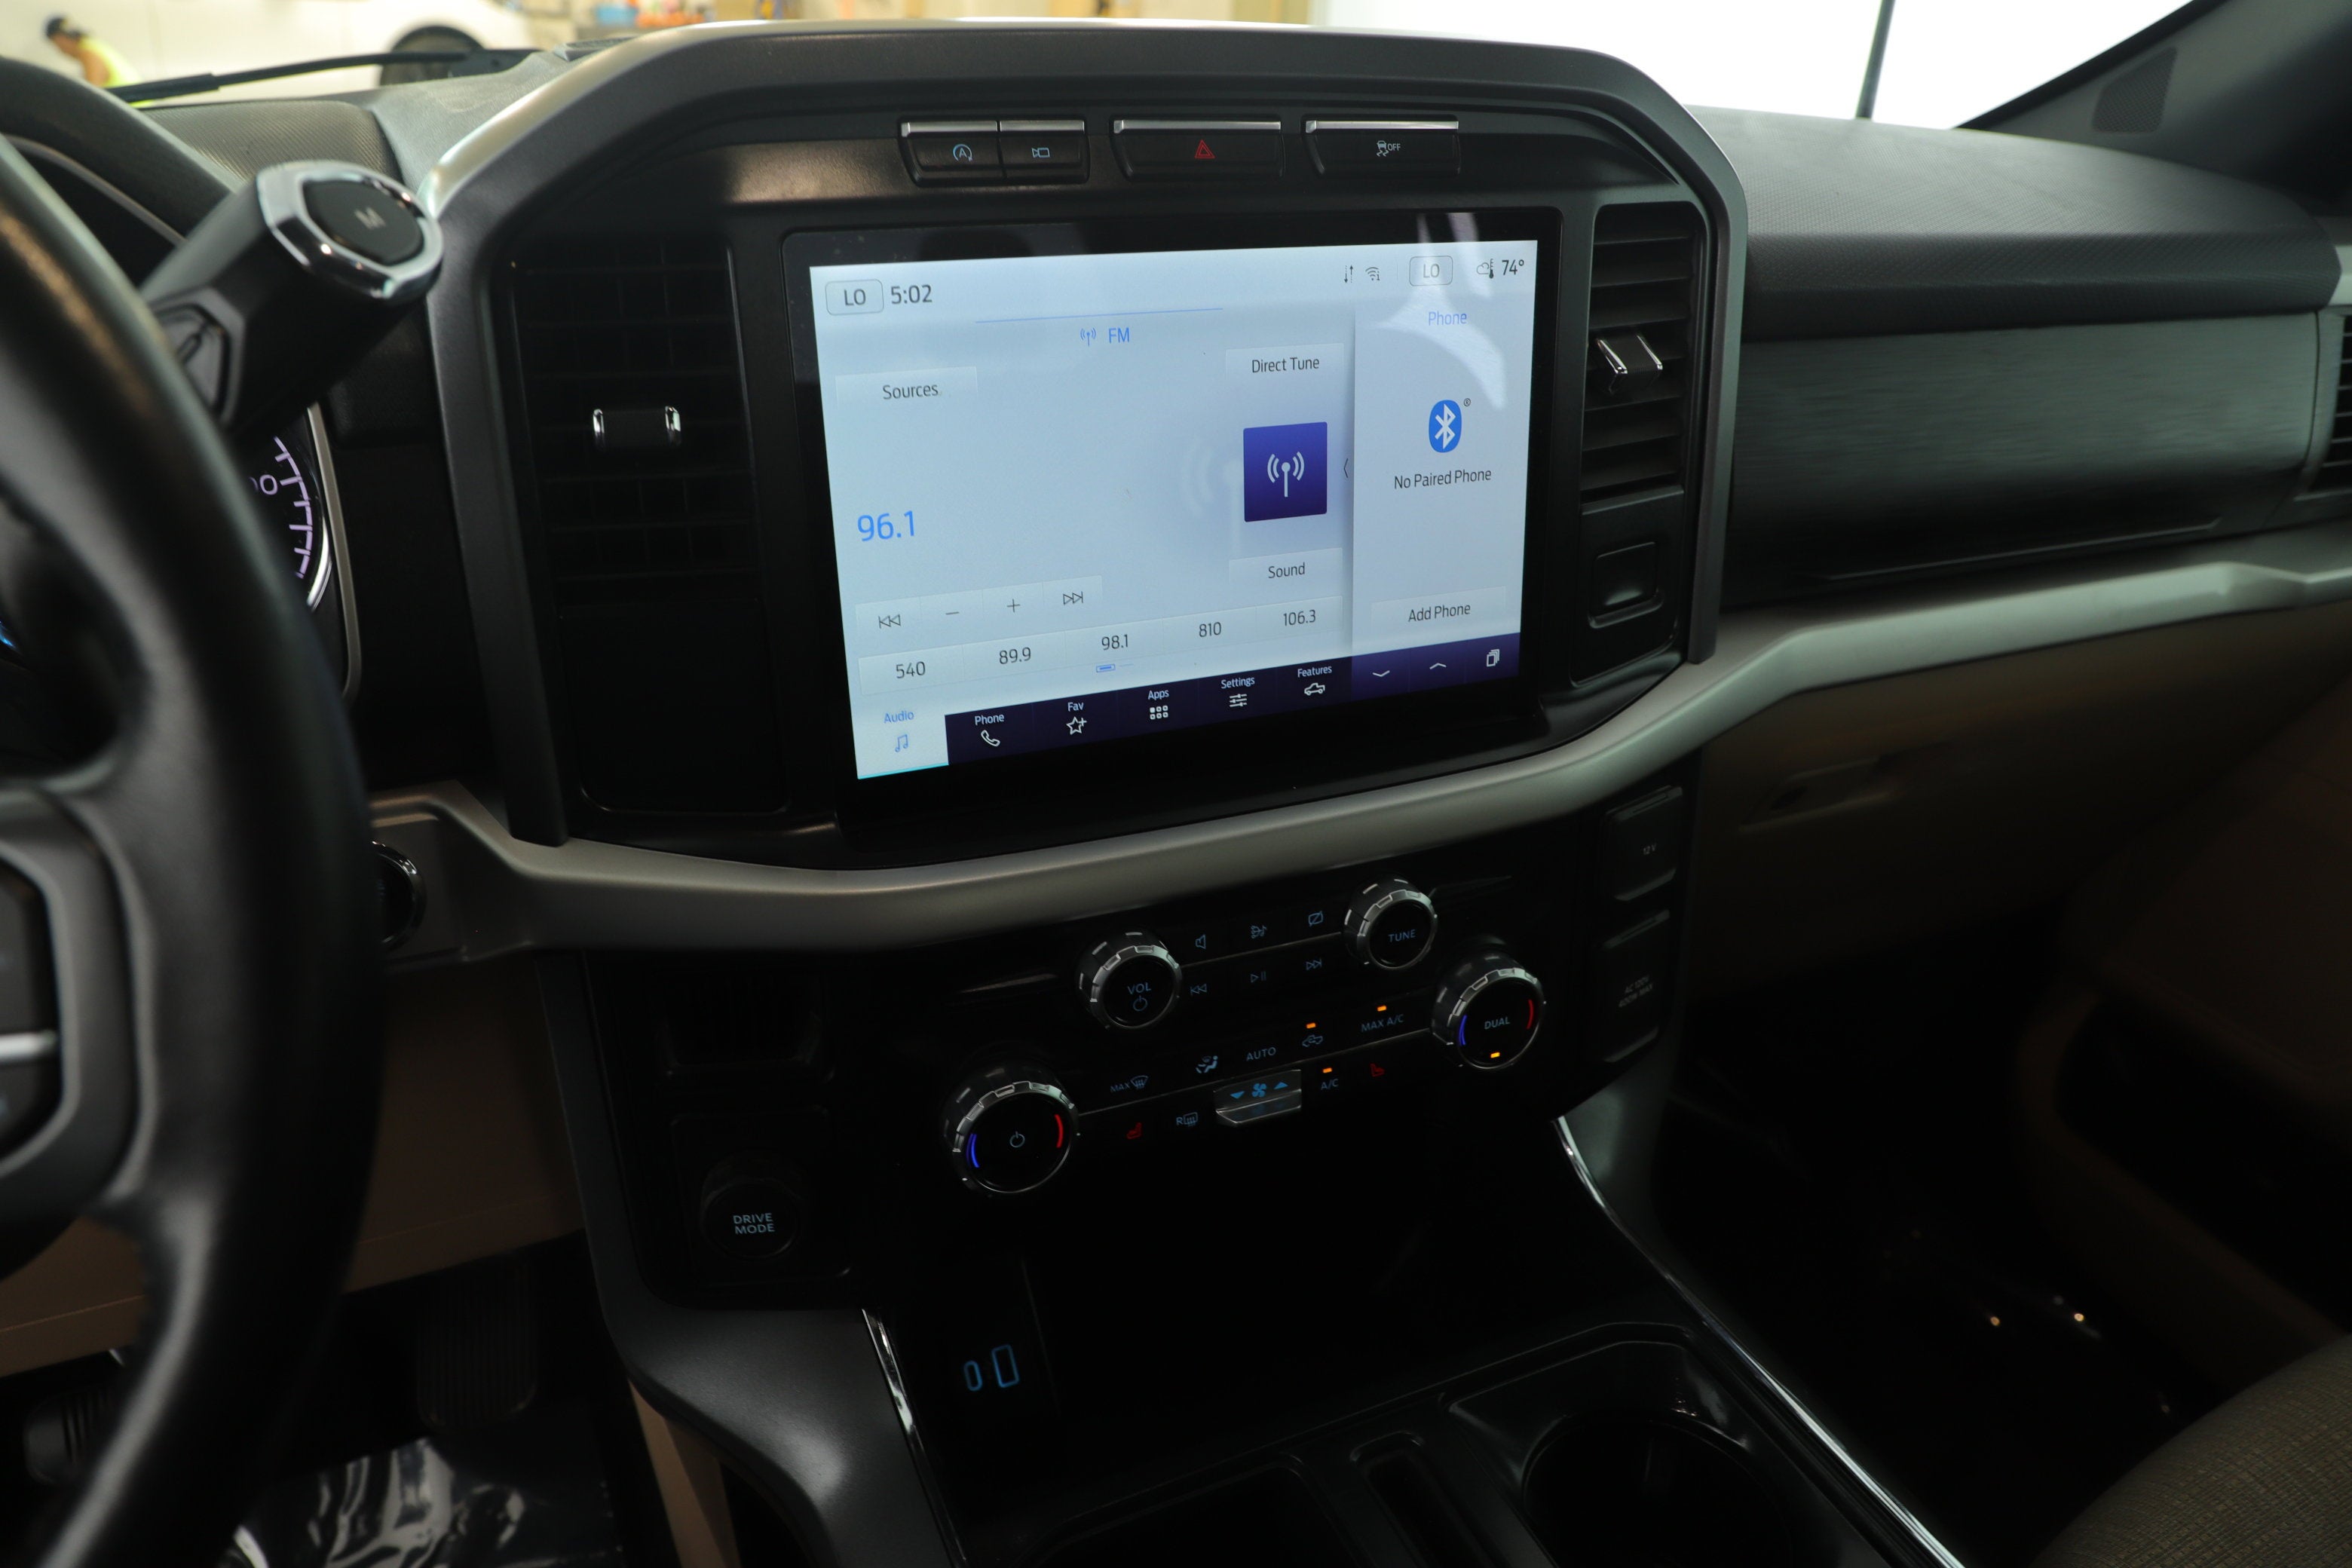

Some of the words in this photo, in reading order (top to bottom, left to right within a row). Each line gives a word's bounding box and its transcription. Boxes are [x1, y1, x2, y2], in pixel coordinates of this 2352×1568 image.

[1388, 142, 1401, 152] OFF
[1423, 262, 1440, 279] LO
[1502, 259, 1525, 276] 74°
[844, 289, 866, 306] LO
[890, 284, 933, 305] 5:02
[1427, 310, 1467, 326] Phone
[1108, 327, 1130, 343] FM
[1251, 358, 1287, 373] Direct
[1289, 356, 1319, 370] Tune
[882, 382, 939, 400] Sources
[1394, 475, 1411, 489] No
[1413, 470, 1452, 487] Paired
[1454, 468, 1492, 484] Phone
[857, 510, 915, 541] 96.1
[1268, 562, 1306, 579] Sound
[1282, 609, 1316, 626] 106.3
[1408, 607, 1432, 623] Add
[1435, 602, 1471, 619] Phone
[1199, 622, 1222, 638] 810
[1101, 634, 1129, 651] 98.1
[999, 647, 1031, 665] 89.9
[895, 660, 926, 678] 540
[1297, 664, 1332, 678] Features
[1221, 675, 1255, 690] Settings
[1148, 688, 1169, 702] Apps
[1067, 701, 1084, 712] Fav
[884, 710, 914, 724] Audio
[975, 712, 1005, 726] Phone
[1389, 929, 1416, 942] TUNE
[1128, 982, 1152, 994] VOL
[1361, 1020, 1385, 1032] MAX
[1387, 1014, 1404, 1027] A/C
[1484, 1018, 1511, 1030] DUAL
[1246, 1047, 1277, 1061] AUTO
[1110, 1083, 1131, 1092] MAX
[1321, 1077, 1339, 1090] A/C
[733, 1212, 773, 1224] DRIVE
[734, 1223, 776, 1235] MODE
